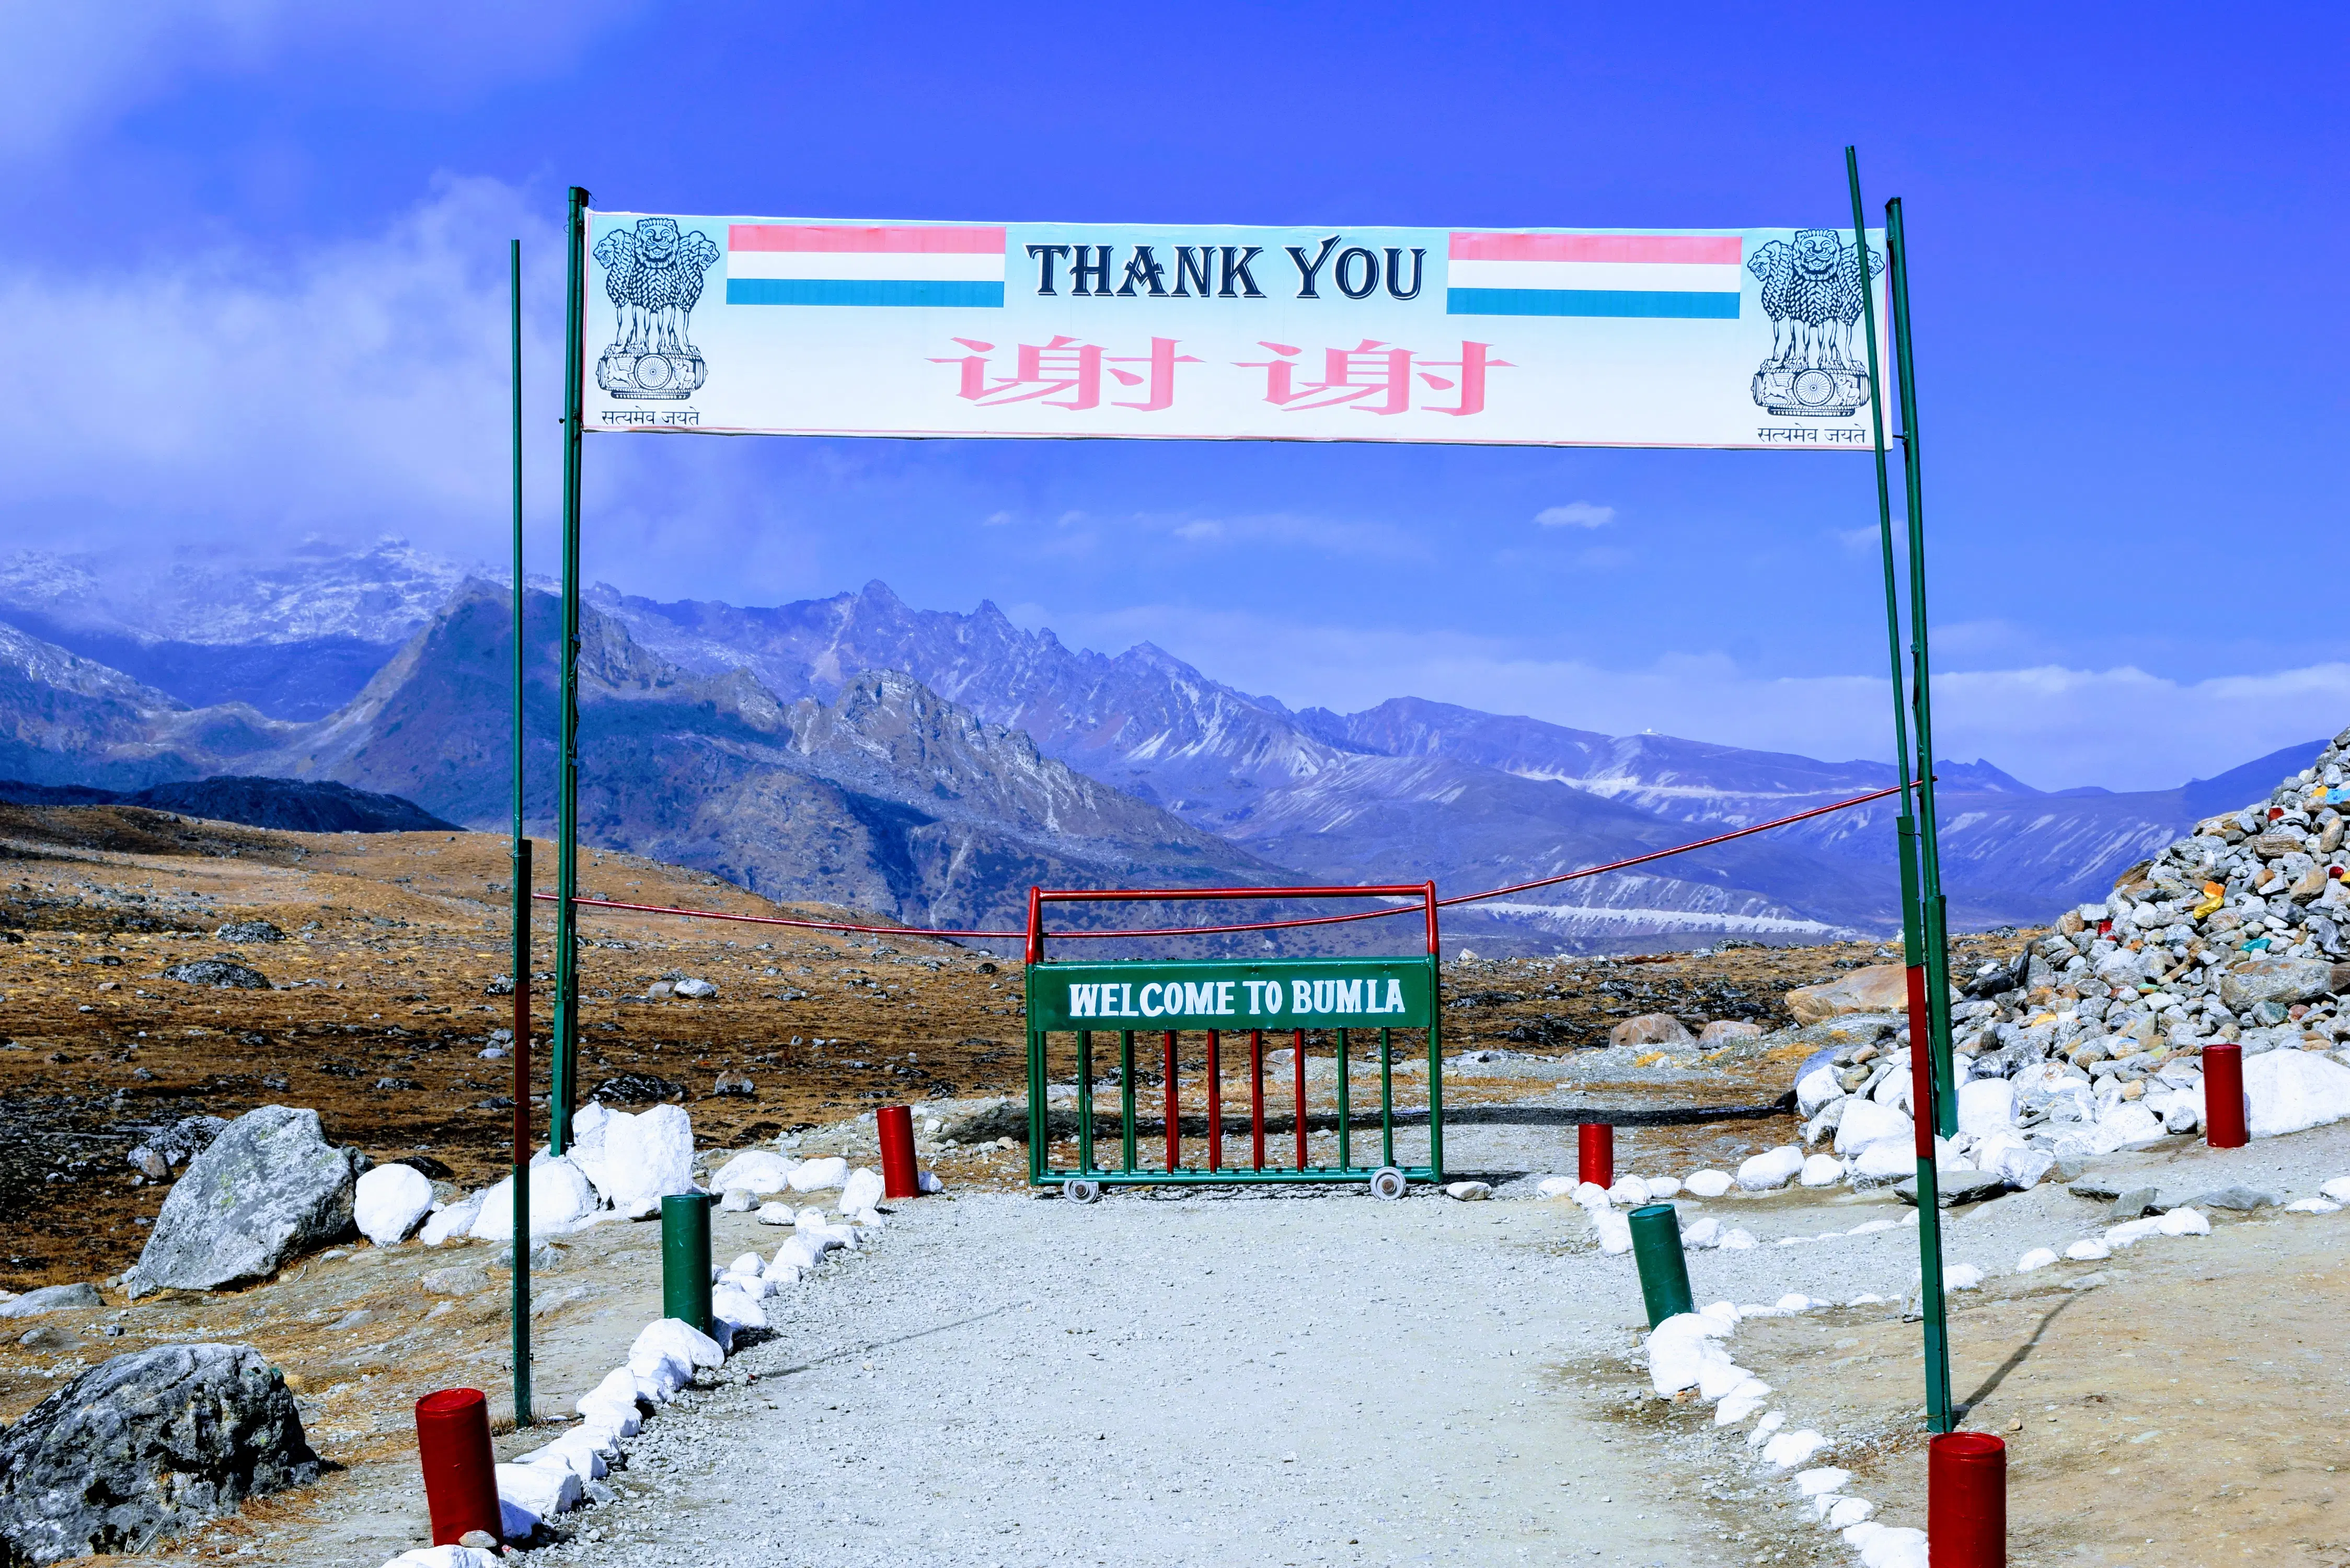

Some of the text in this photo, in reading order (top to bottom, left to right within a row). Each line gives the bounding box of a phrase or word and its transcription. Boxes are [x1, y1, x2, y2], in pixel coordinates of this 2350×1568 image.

[1024, 234, 1427, 301] THANK YOU
[601, 405, 700, 425] सत्यमेव जयते
[1757, 422, 1867, 444] सत्यमेव जयते
[1068, 981, 1236, 1017] WELCOME
[1242, 980, 1283, 1014] TO
